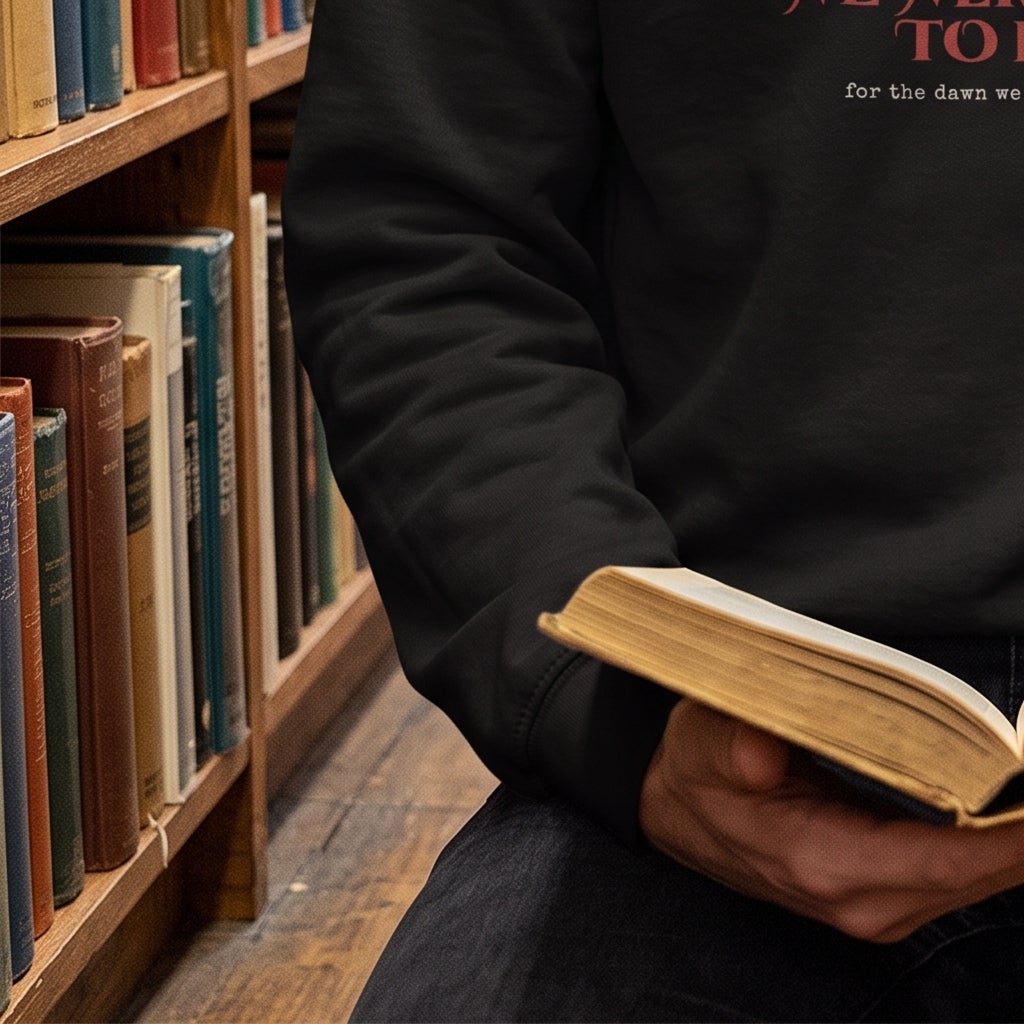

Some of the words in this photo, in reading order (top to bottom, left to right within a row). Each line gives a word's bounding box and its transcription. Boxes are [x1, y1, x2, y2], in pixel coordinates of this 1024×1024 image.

[894, 18, 998, 63] TO
[845, 81, 882, 99] for
[889, 83, 926, 100] the
[934, 83, 988, 101] dawn
[995, 88, 1021, 101] we
